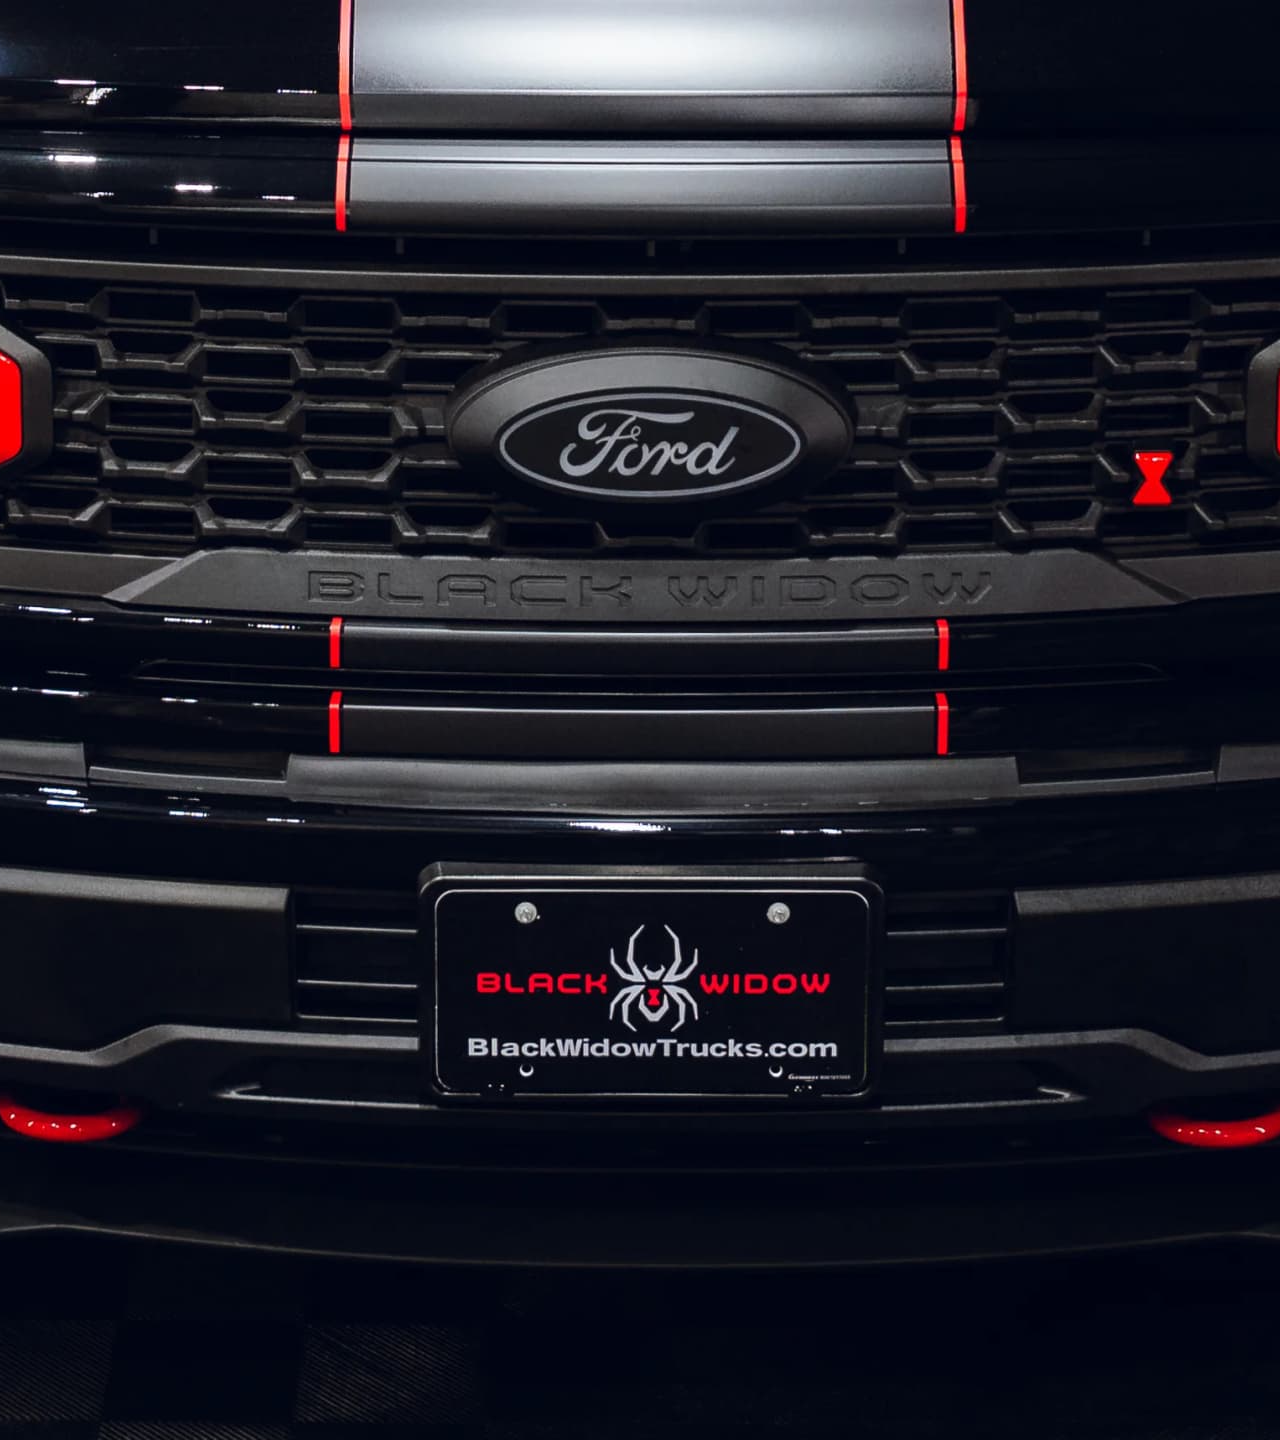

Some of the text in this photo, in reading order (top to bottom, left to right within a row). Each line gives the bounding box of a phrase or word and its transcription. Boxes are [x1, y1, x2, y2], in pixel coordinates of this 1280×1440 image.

[559, 409, 740, 477] Ford
[307, 570, 993, 608] BLACK WIDOW
[475, 971, 832, 996] BLACK WIDOW
[466, 1036, 839, 1059] BlackWidowTrucks.com
